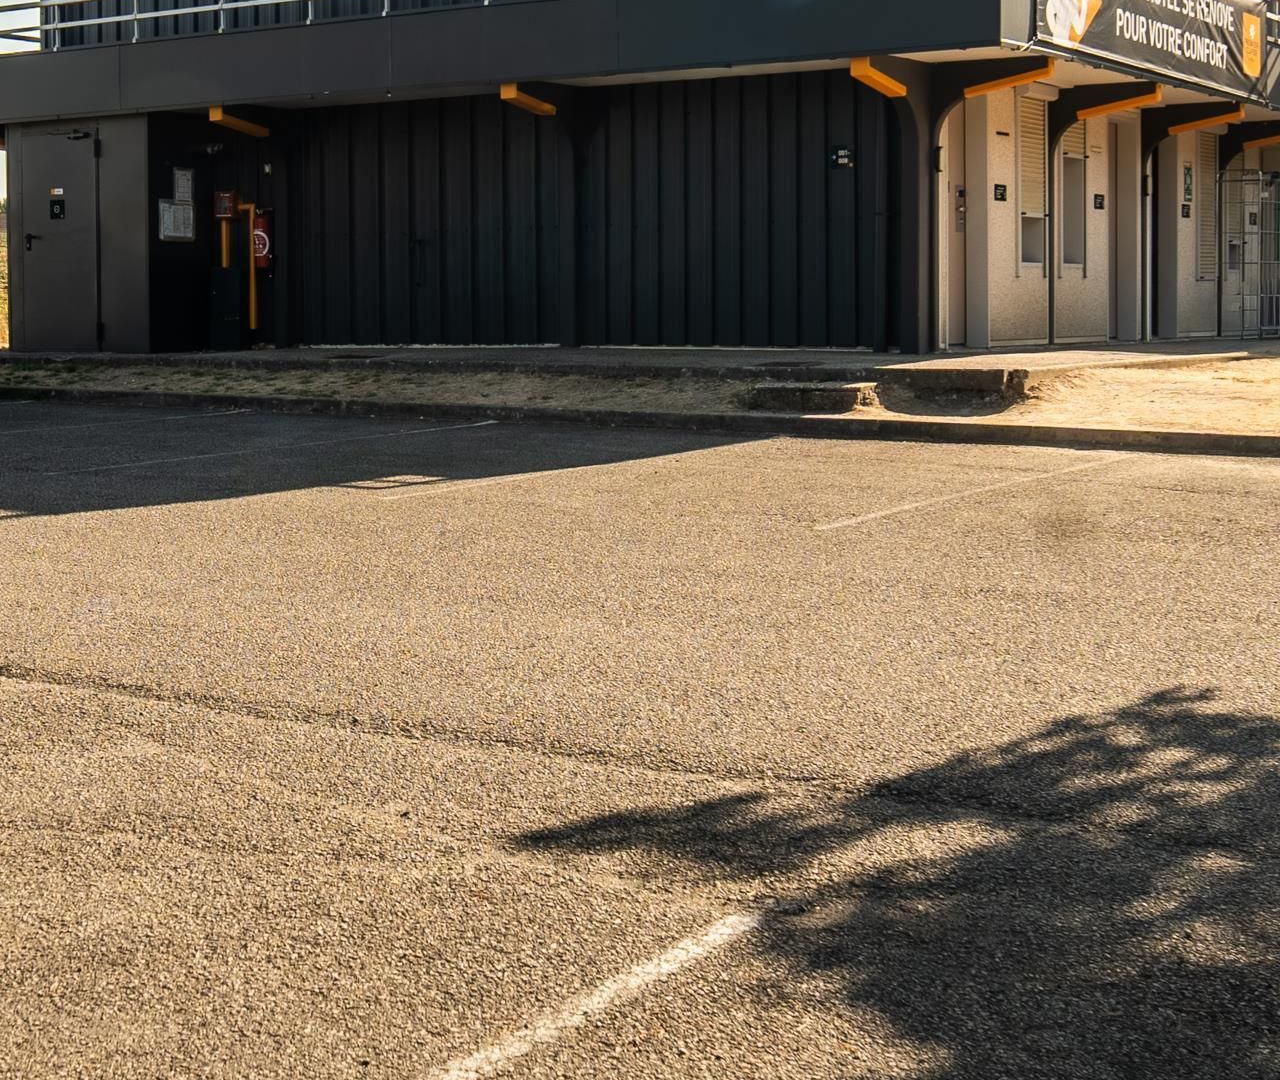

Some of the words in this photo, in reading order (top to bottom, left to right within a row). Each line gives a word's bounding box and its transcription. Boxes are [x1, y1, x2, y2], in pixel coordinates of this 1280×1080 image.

[1116, 8, 1147, 45] POUR
[1148, 19, 1182, 56] VOTRE
[1183, 32, 1228, 69] CONFORT
